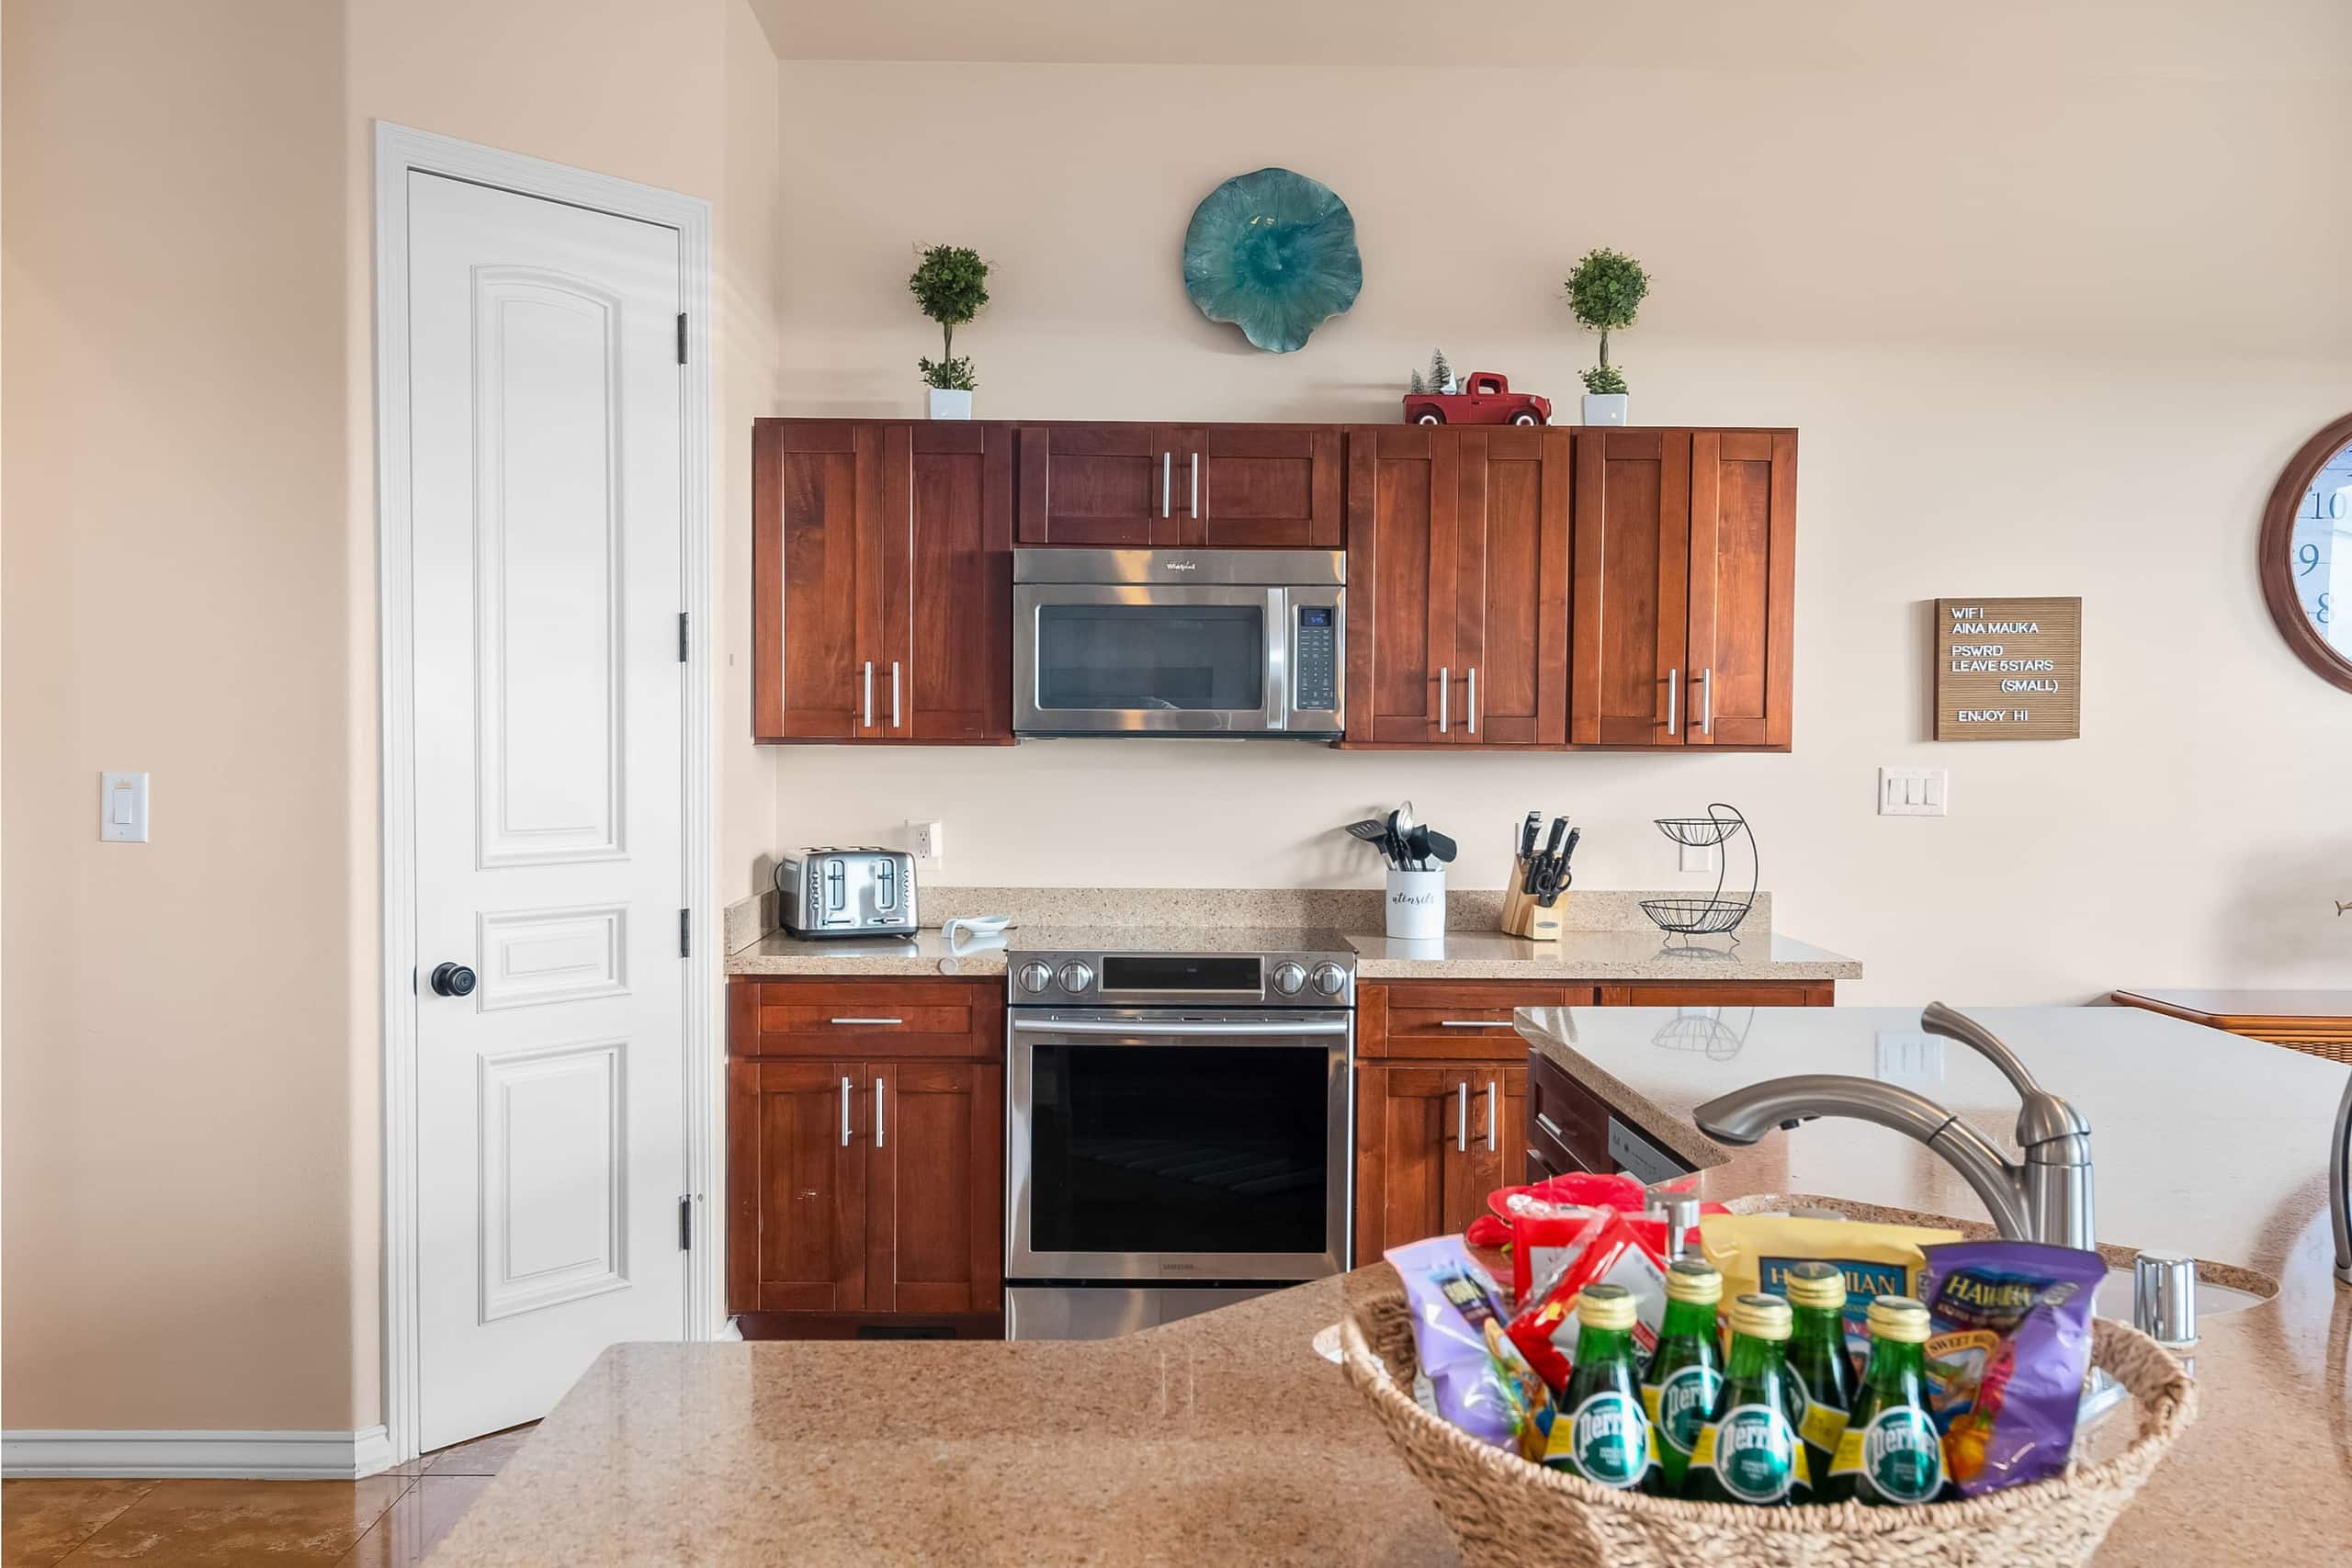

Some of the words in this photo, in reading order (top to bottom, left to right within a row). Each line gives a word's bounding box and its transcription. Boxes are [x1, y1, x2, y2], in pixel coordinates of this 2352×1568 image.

[2299, 544, 2320, 577] 9
[1951, 607, 1984, 619] WIFI
[1951, 623, 1986, 634] AINA
[1987, 622, 2040, 634] MAUKA
[1951, 645, 2004, 657] PSWRD
[1951, 660, 1999, 672] LEAVE
[2001, 680, 2058, 693] (SMALL)
[1957, 710, 2007, 722] ENJOY
[2014, 710, 2029, 721] HI
[1770, 1266, 1896, 1296] HIIAN
[1946, 1274, 2031, 1307] HAWAN
[1930, 1334, 1970, 1354] SWEET
